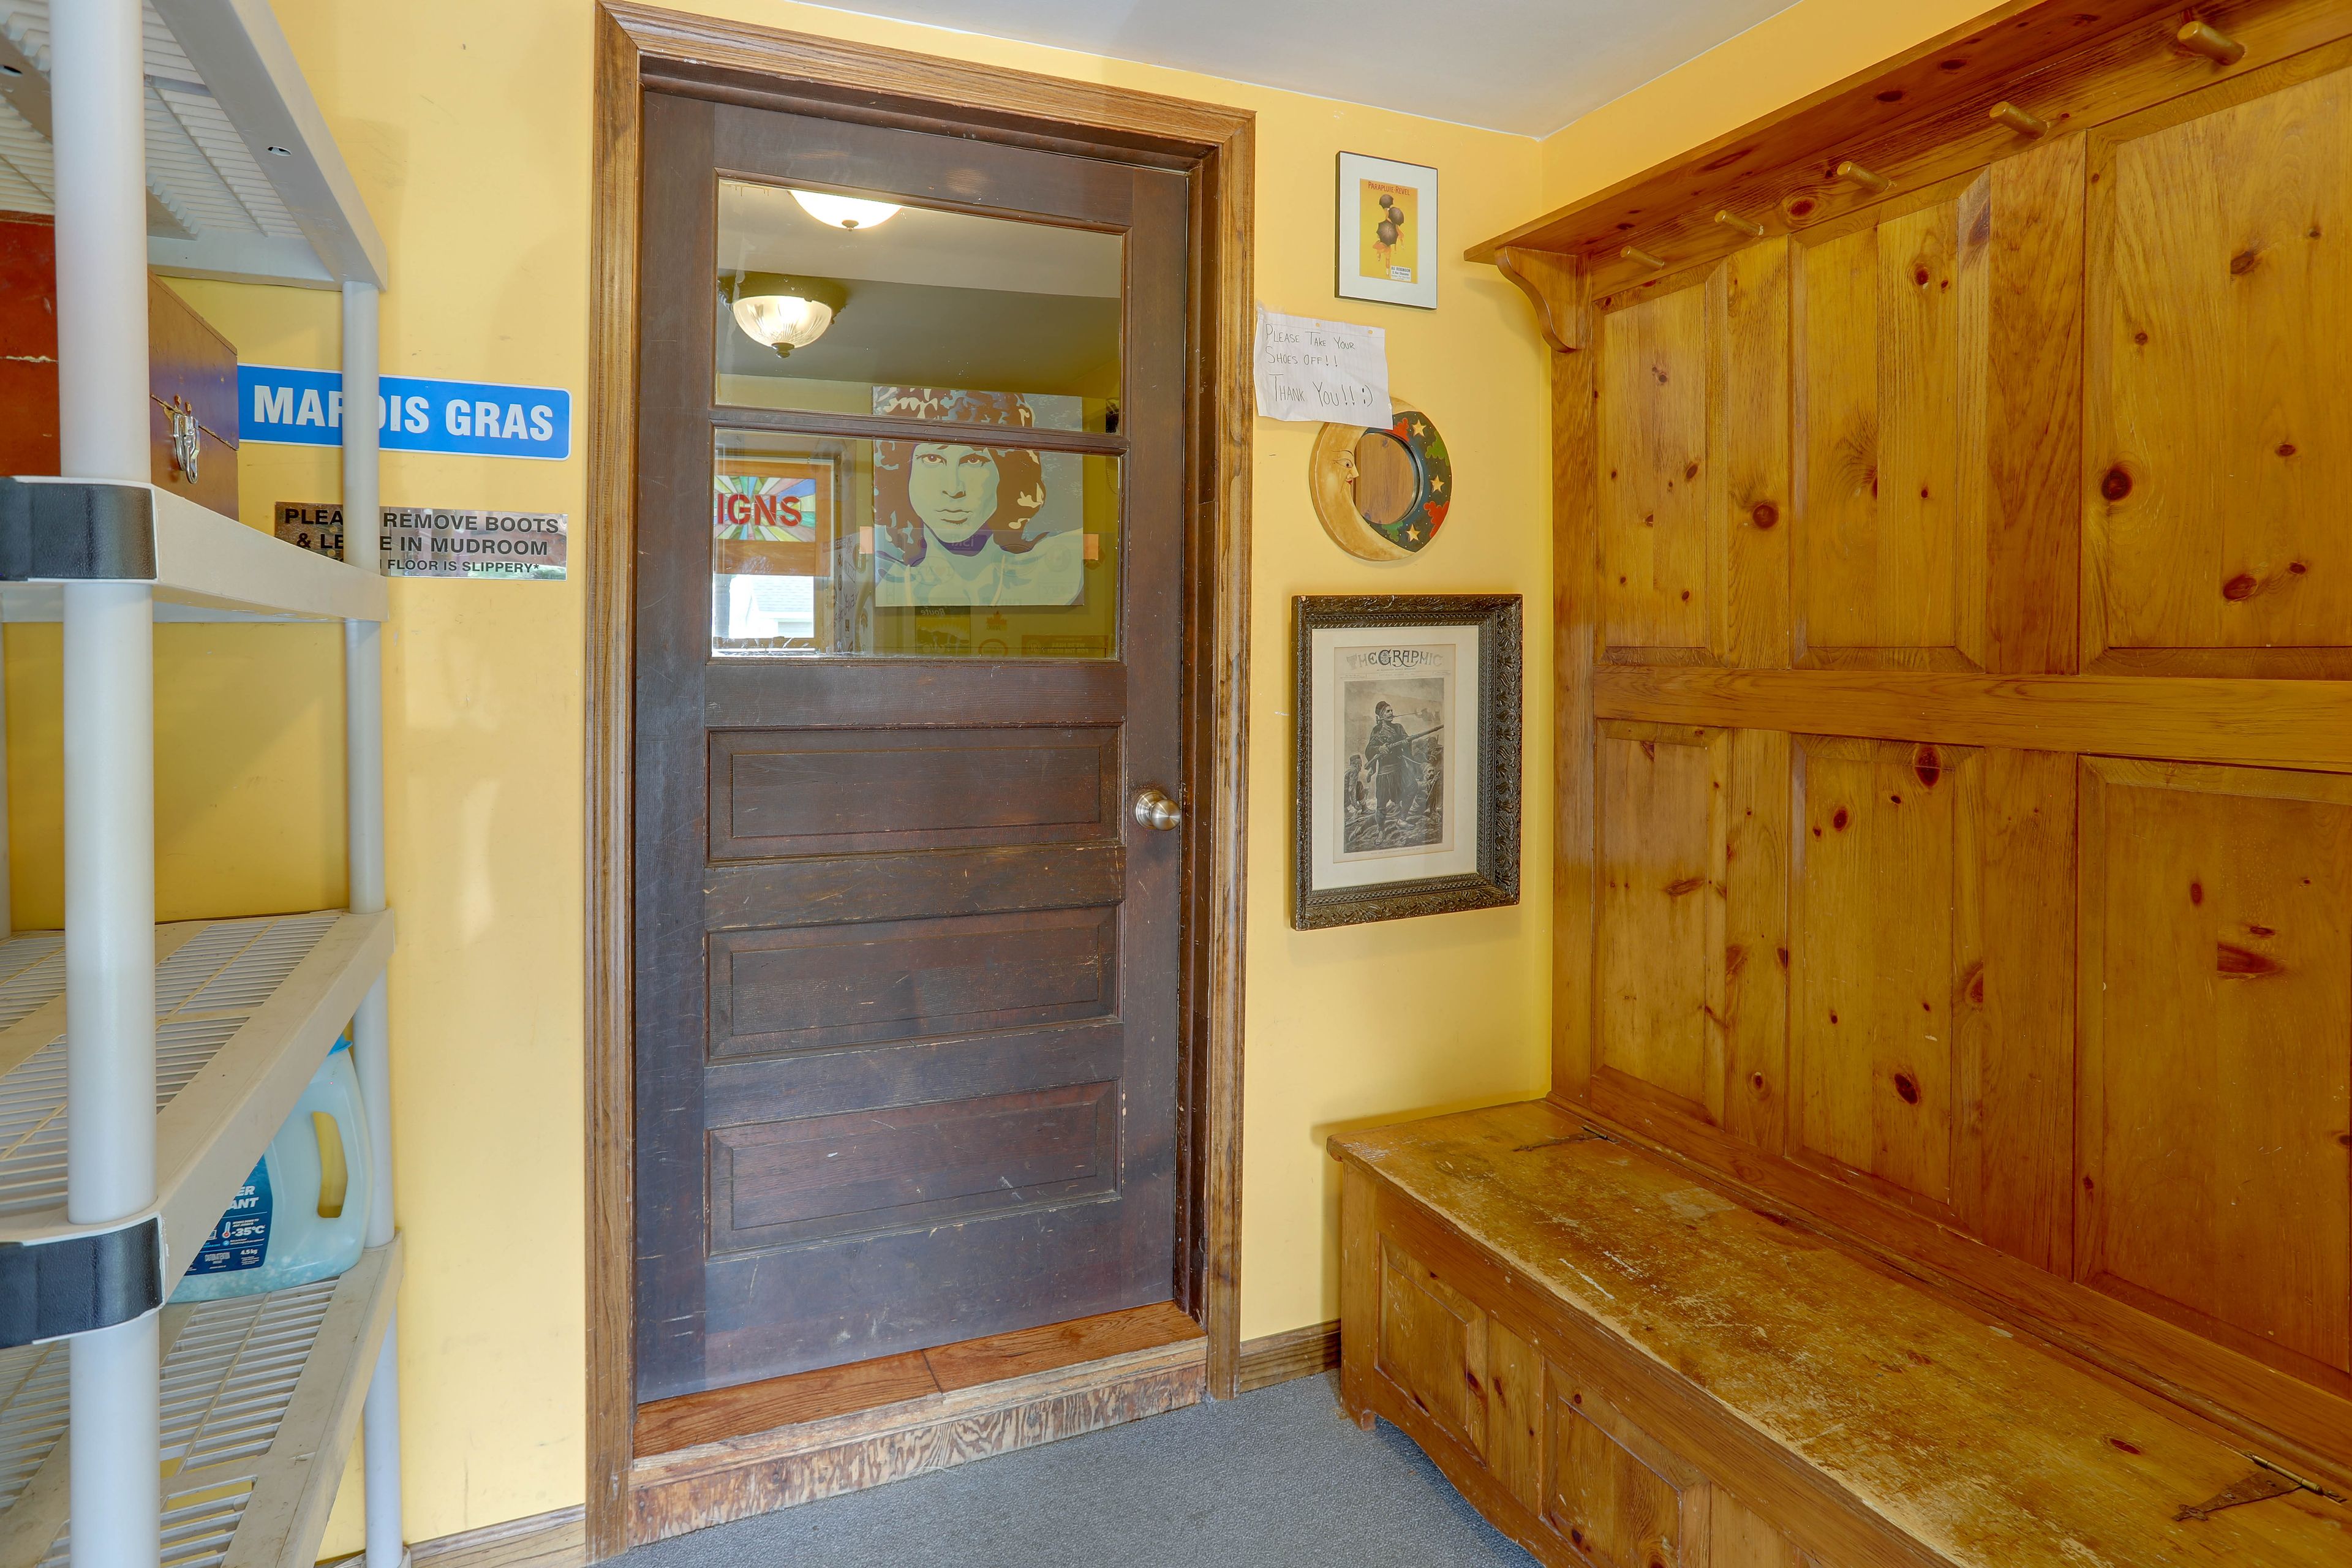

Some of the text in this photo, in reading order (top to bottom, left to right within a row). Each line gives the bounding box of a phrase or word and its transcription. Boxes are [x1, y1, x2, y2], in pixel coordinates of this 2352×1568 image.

[1265, 323, 1356, 350] PLEASE TAKE YOUR
[1265, 345, 1298, 364] SHOES
[1268, 374, 1305, 402] THANK
[445, 399, 554, 442] GRAS
[285, 508, 559, 533] PLEA REMOVE BOOTS
[297, 532, 548, 556] & LEE IN MUDROOM
[387, 559, 439, 571] FLOOR
[443, 560, 458, 571] IS
[1346, 649, 1444, 670] THE GRAPHIC
